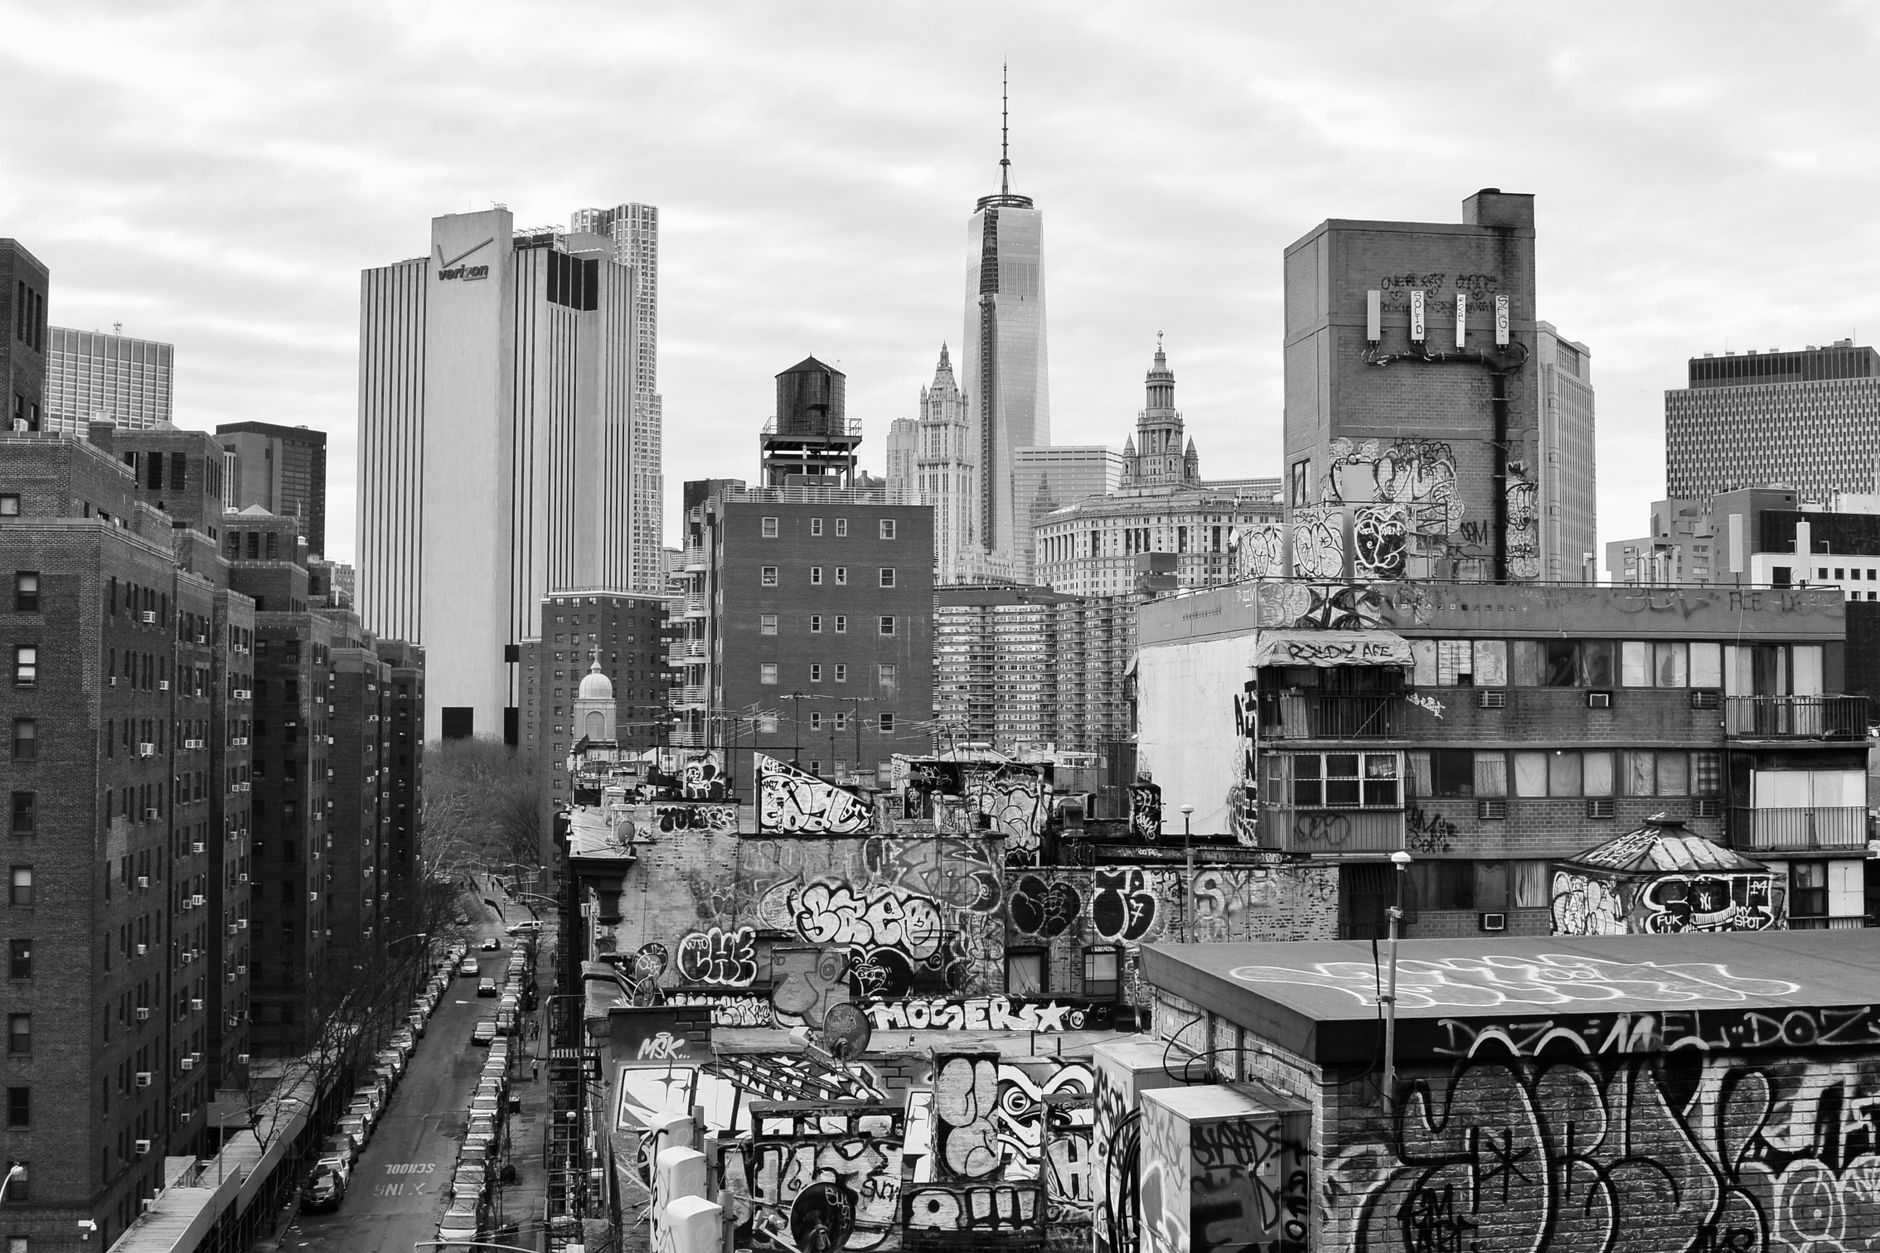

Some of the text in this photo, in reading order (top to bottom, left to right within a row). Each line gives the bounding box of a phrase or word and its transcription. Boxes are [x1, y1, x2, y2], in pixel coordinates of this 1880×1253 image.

[438, 263, 489, 281] verizon
[1736, 906, 1752, 917] MY
[1656, 914, 1683, 926] FUK
[1734, 916, 1766, 930] SPOT
[384, 1163, 436, 1175] SCHOOL
